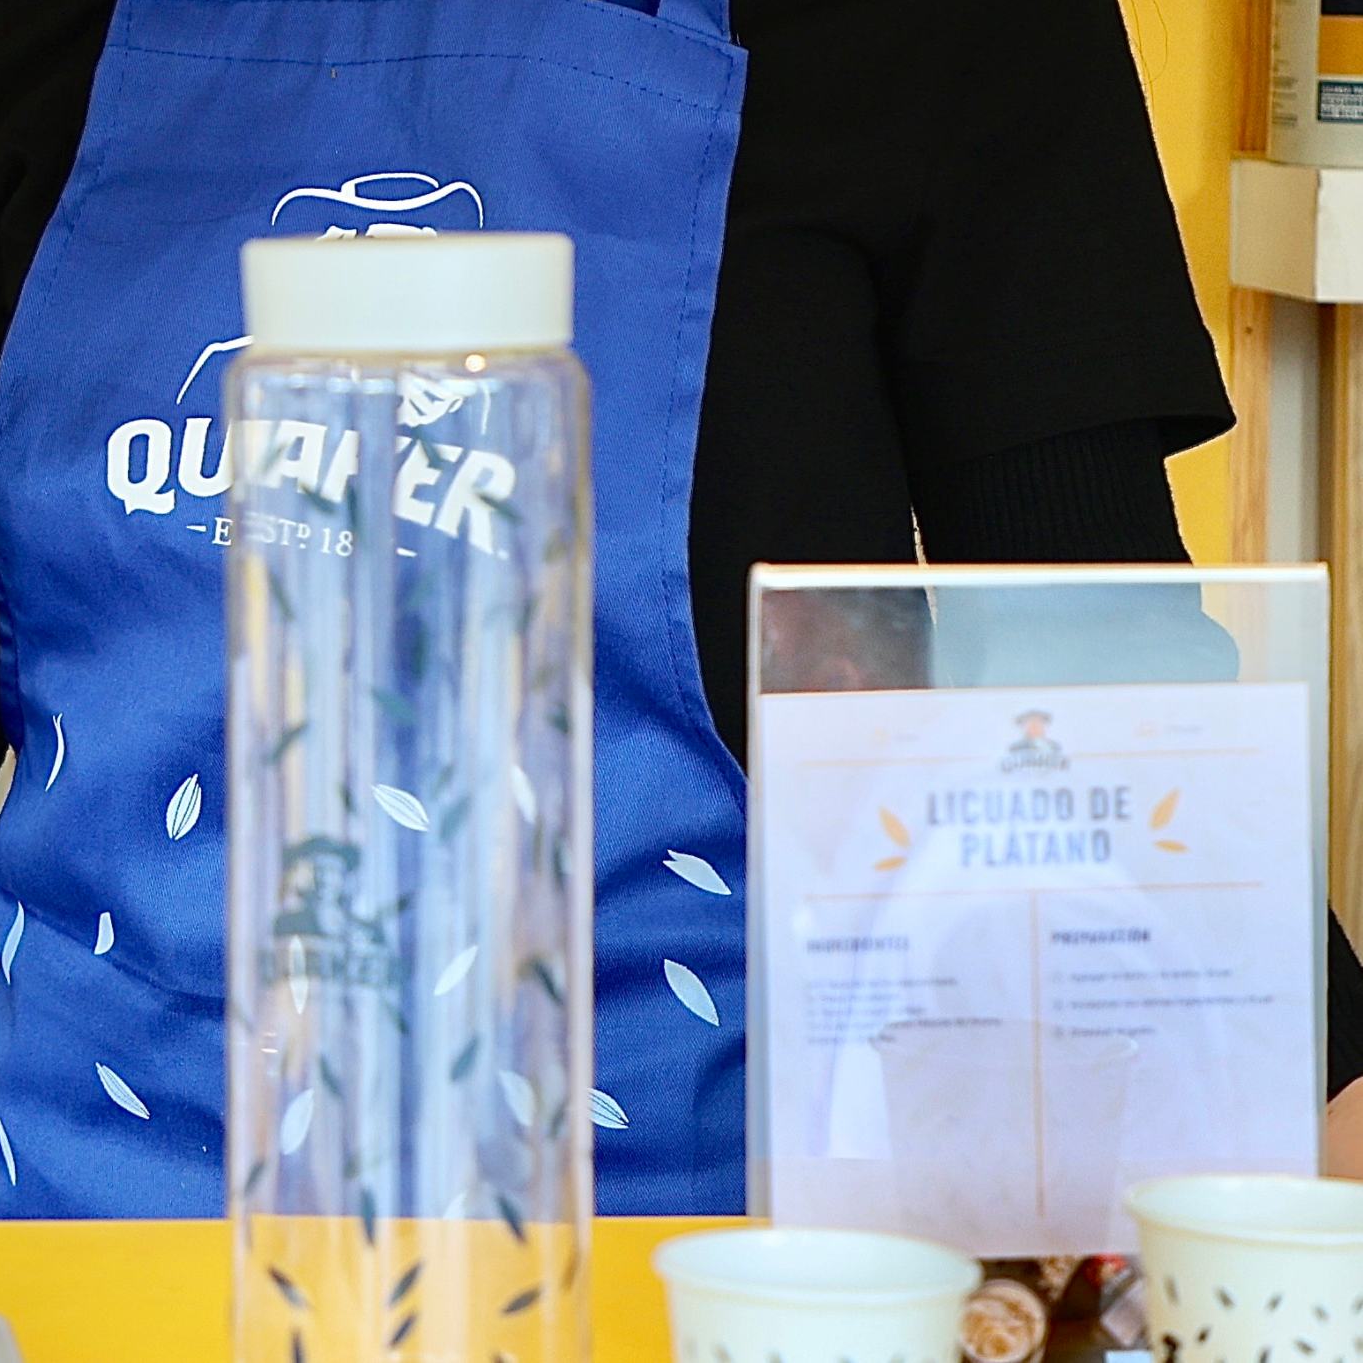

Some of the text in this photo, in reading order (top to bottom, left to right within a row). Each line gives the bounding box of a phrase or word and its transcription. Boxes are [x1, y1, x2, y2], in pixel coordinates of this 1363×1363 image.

[321, 528, 354, 557] 18
[927, 786, 1132, 826] LICUADO DE
